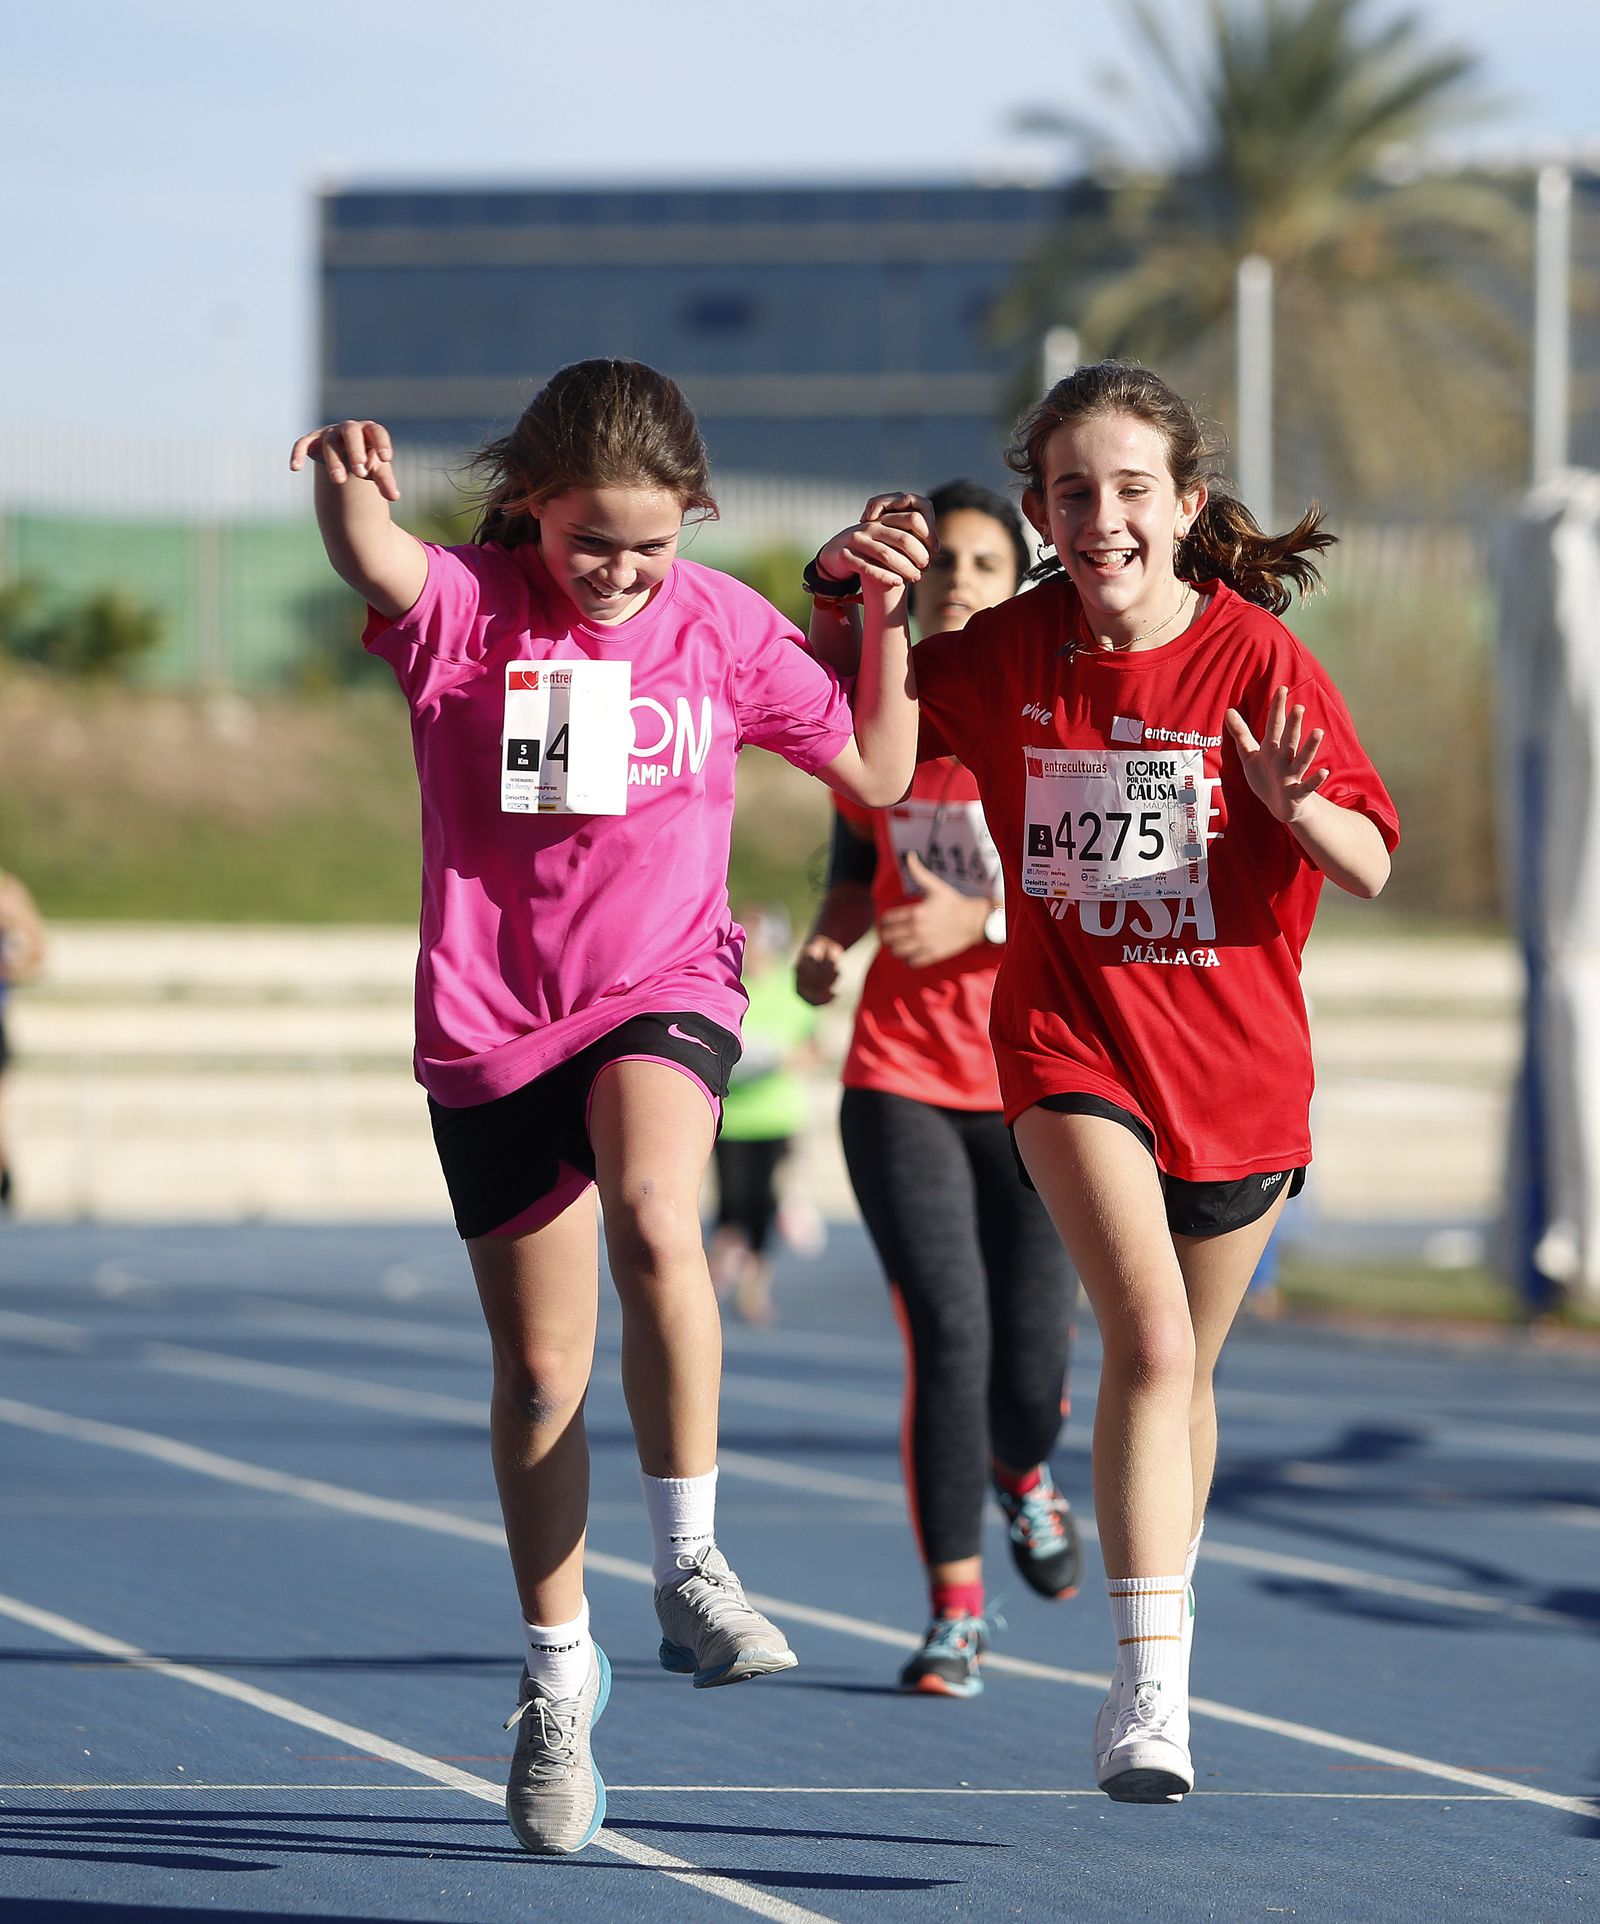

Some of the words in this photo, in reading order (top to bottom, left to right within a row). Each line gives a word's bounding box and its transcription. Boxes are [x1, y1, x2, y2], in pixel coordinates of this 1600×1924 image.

[1021, 702, 1053, 726] vive
[1144, 726, 1222, 748] entreculturas
[520, 744, 528, 756] 5
[1044, 760, 1108, 774] entreculturas
[1126, 760, 1178, 779] CORRE
[1126, 776, 1139, 784] POR
[1126, 783, 1178, 801] CAUSA
[1039, 830, 1046, 841] 5
[1054, 811, 1165, 862] 4275
[1121, 942, 1221, 968] MÁLAGA
